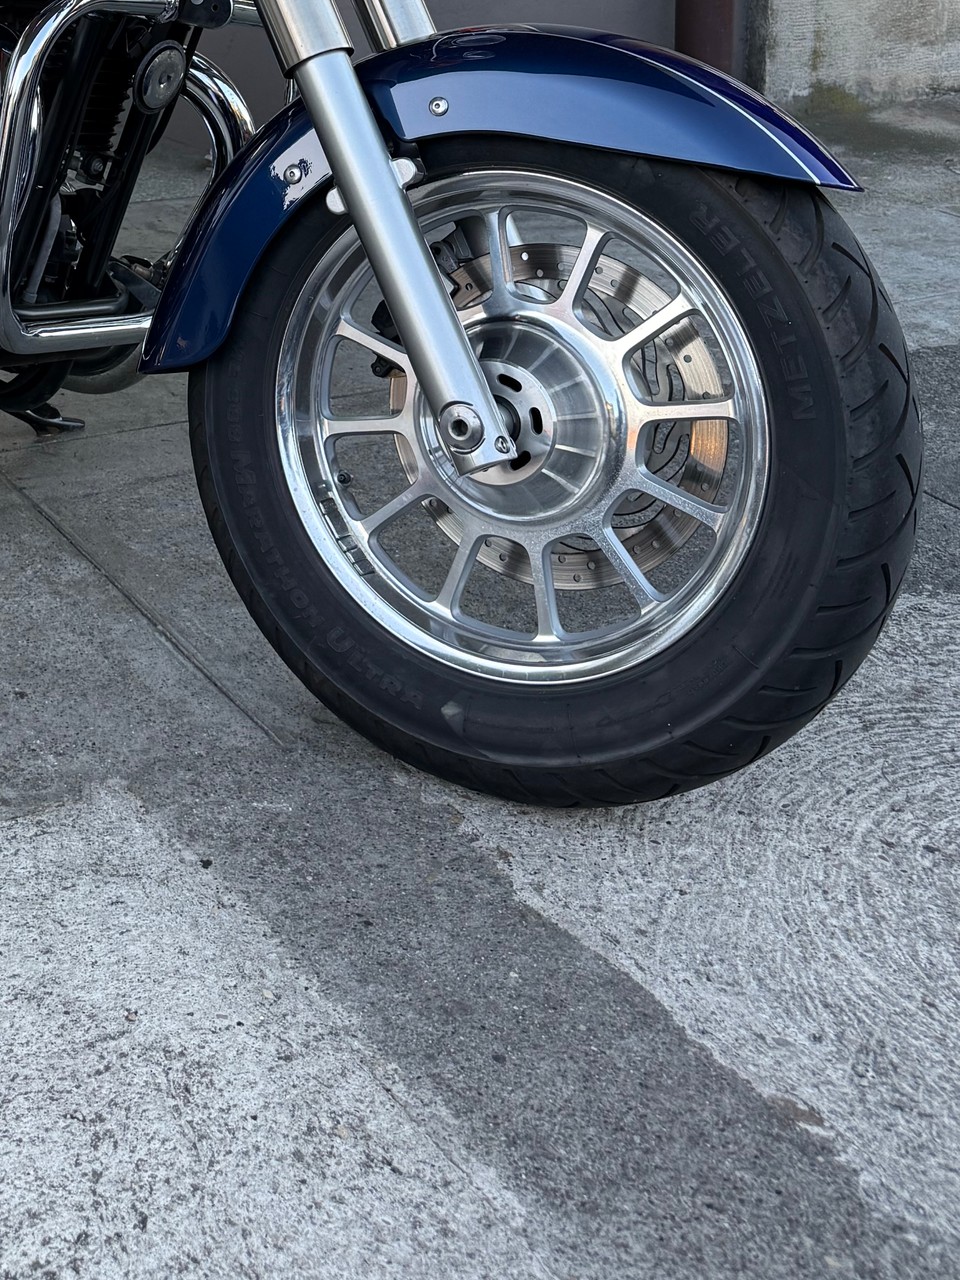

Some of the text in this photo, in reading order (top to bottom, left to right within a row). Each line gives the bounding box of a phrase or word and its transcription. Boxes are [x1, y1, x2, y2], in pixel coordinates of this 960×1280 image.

[688, 200, 817, 421] METZELER
[230, 450, 325, 628] MARATHON
[325, 624, 426, 710] ULTRA
